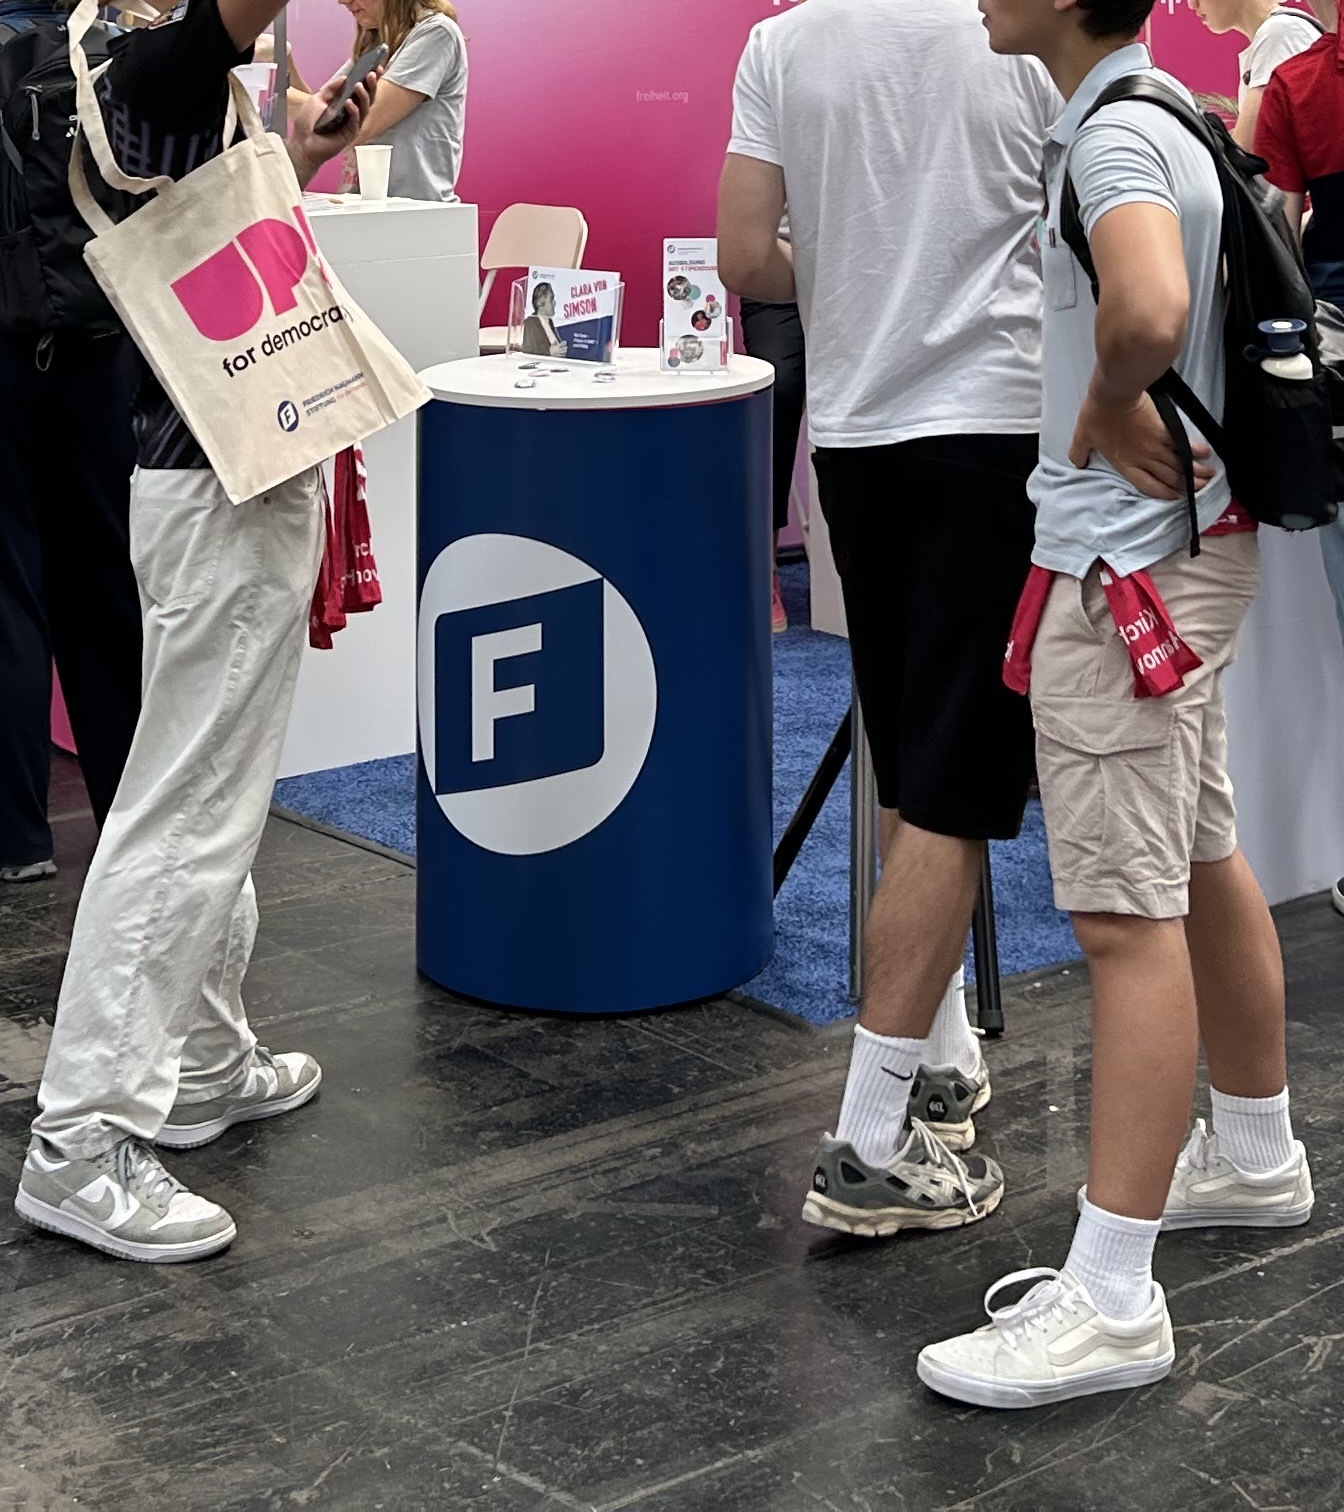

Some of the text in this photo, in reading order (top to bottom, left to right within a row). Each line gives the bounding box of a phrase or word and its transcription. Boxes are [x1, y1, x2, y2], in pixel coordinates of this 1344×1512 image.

[570, 283, 594, 298] CLARA
[563, 296, 598, 319] SIMSON
[222, 345, 257, 378] for
[471, 622, 543, 763] F
